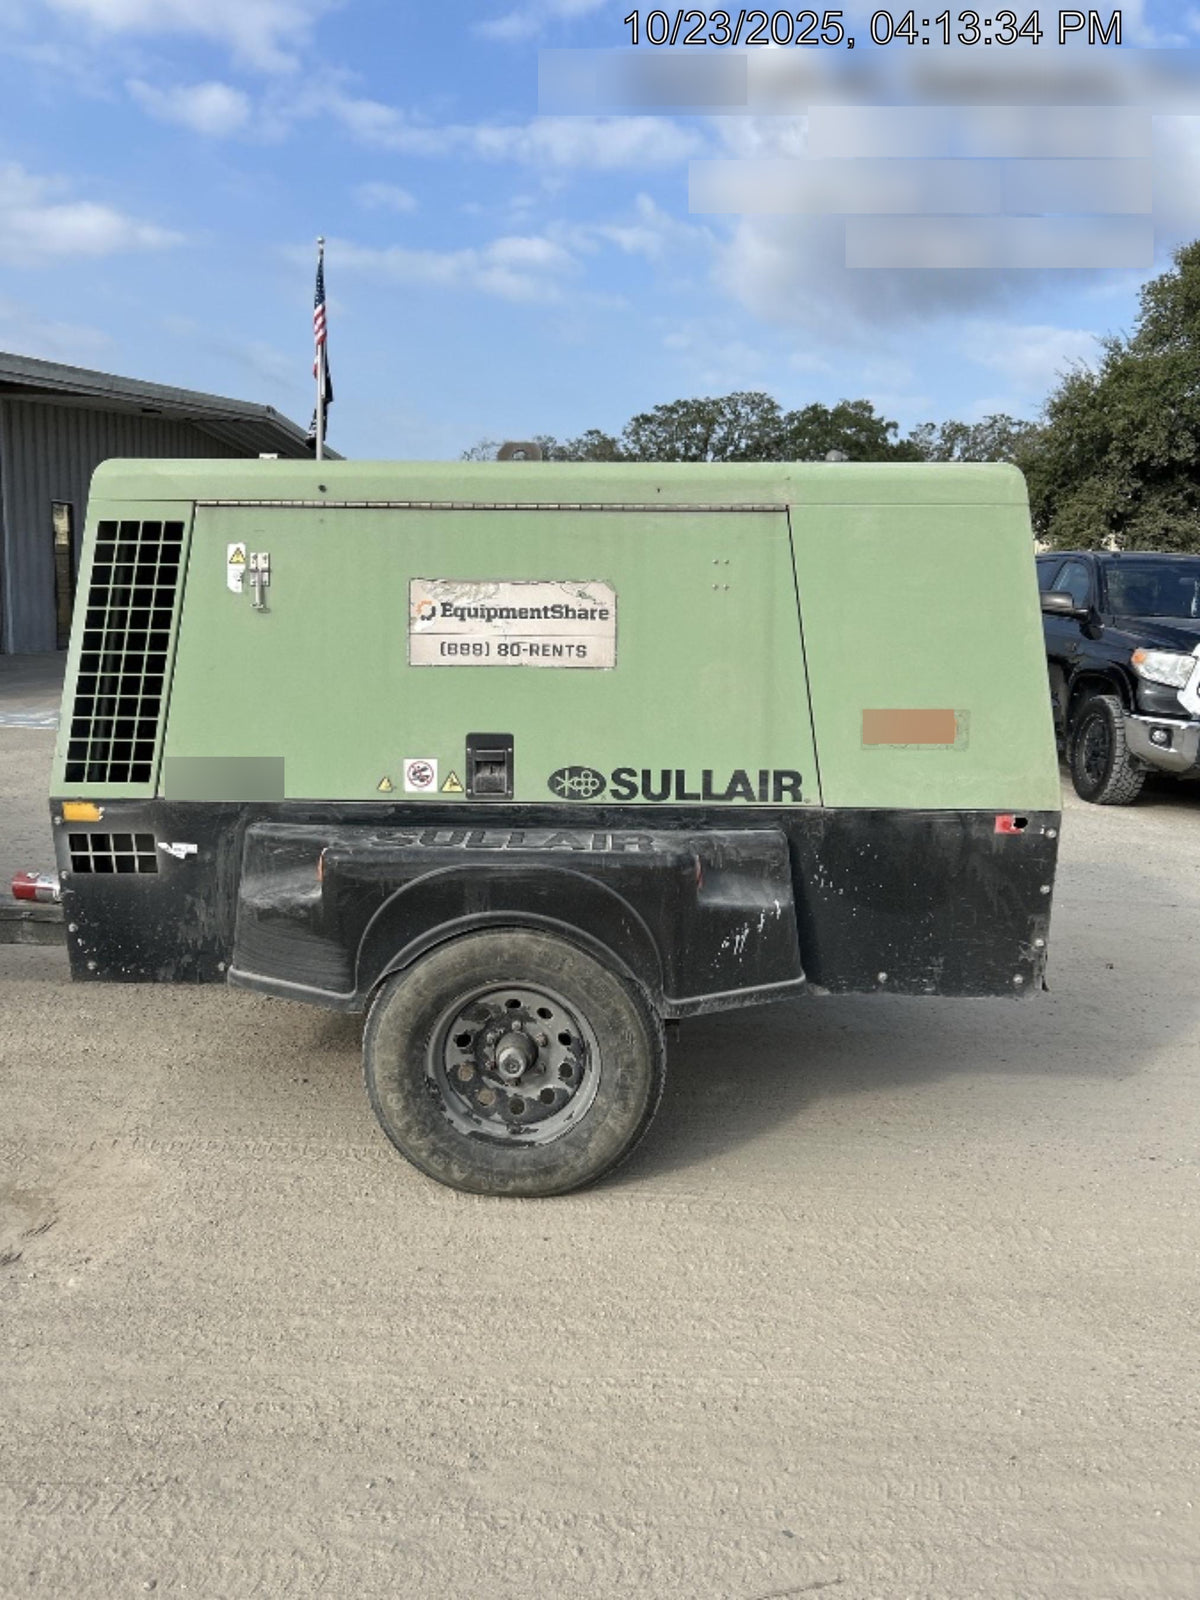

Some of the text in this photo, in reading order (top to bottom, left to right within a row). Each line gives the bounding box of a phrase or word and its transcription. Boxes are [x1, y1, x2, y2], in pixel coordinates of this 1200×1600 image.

[440, 602, 610, 622] EquipmentShare
[440, 641, 588, 658] (888) 80-RENTS
[610, 766, 804, 803] SULLAIR
[371, 830, 659, 853] SULLAIR
